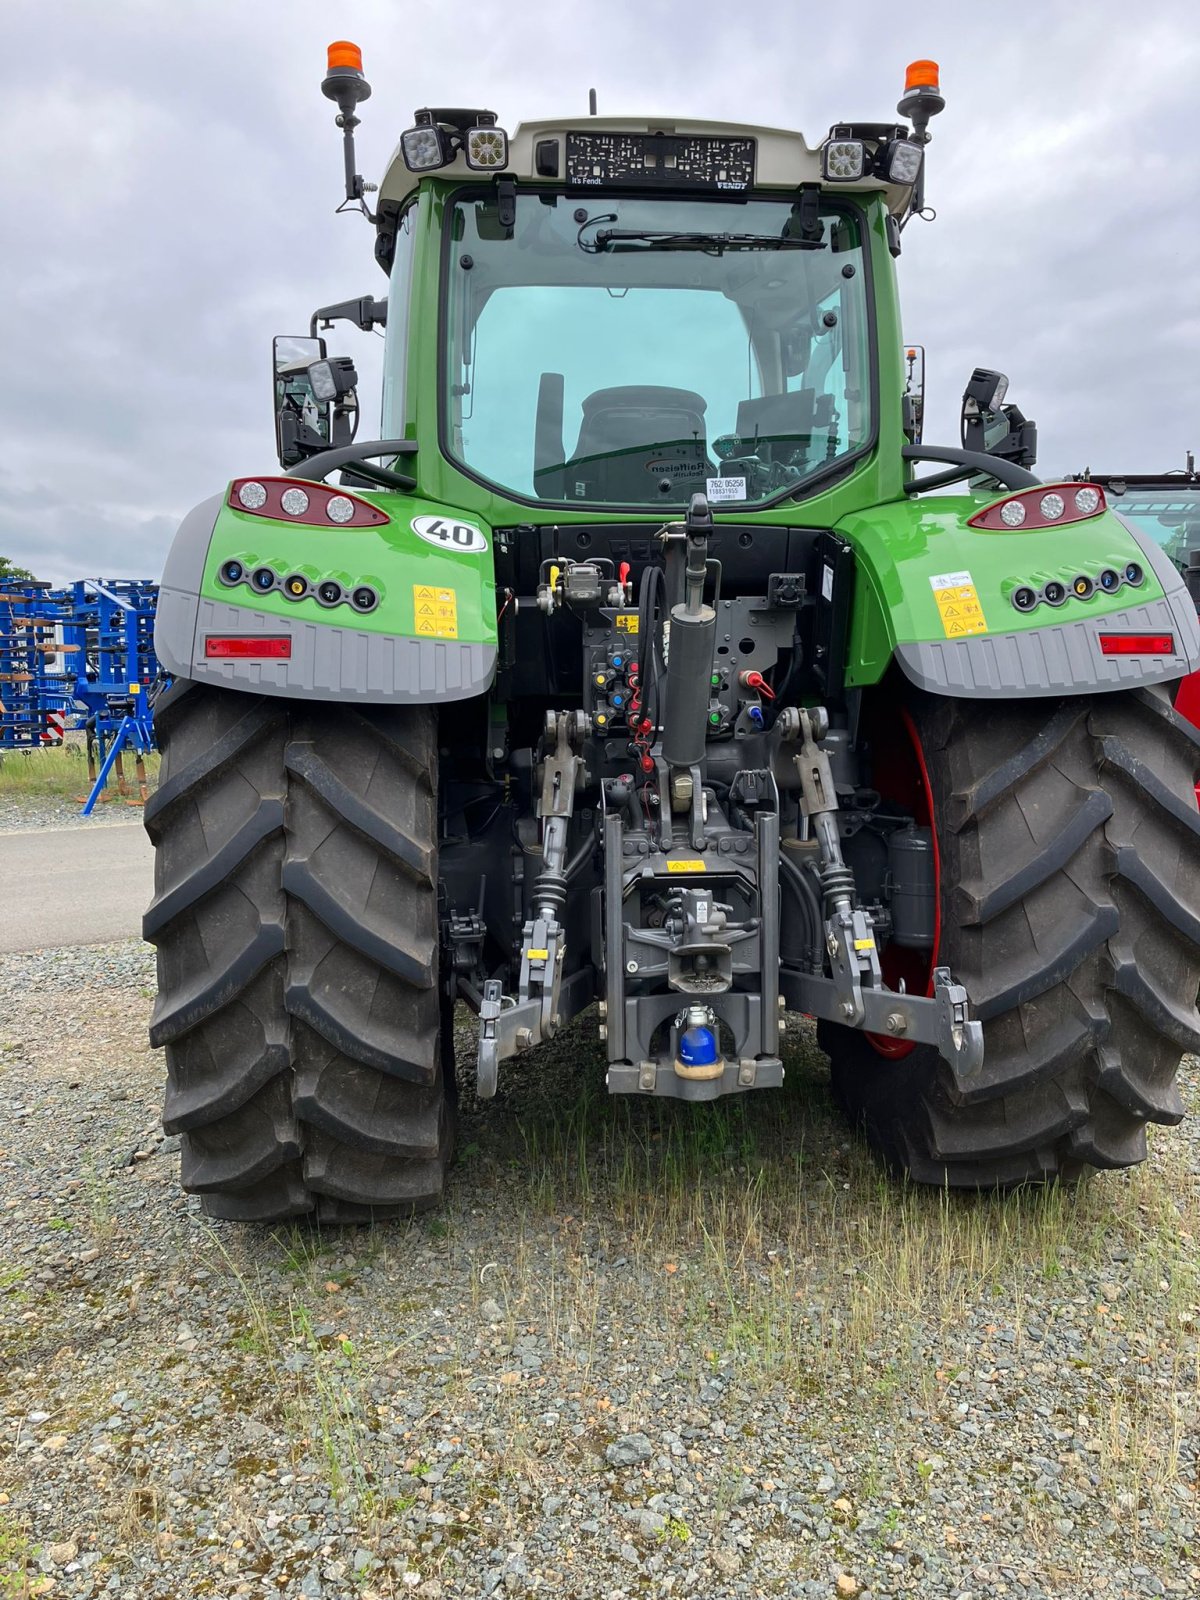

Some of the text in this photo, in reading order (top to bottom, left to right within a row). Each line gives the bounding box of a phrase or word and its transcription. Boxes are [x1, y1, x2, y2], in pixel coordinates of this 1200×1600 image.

[582, 177, 603, 185] Fendt.
[717, 182, 747, 190] FENDT
[426, 521, 473, 546] 40
